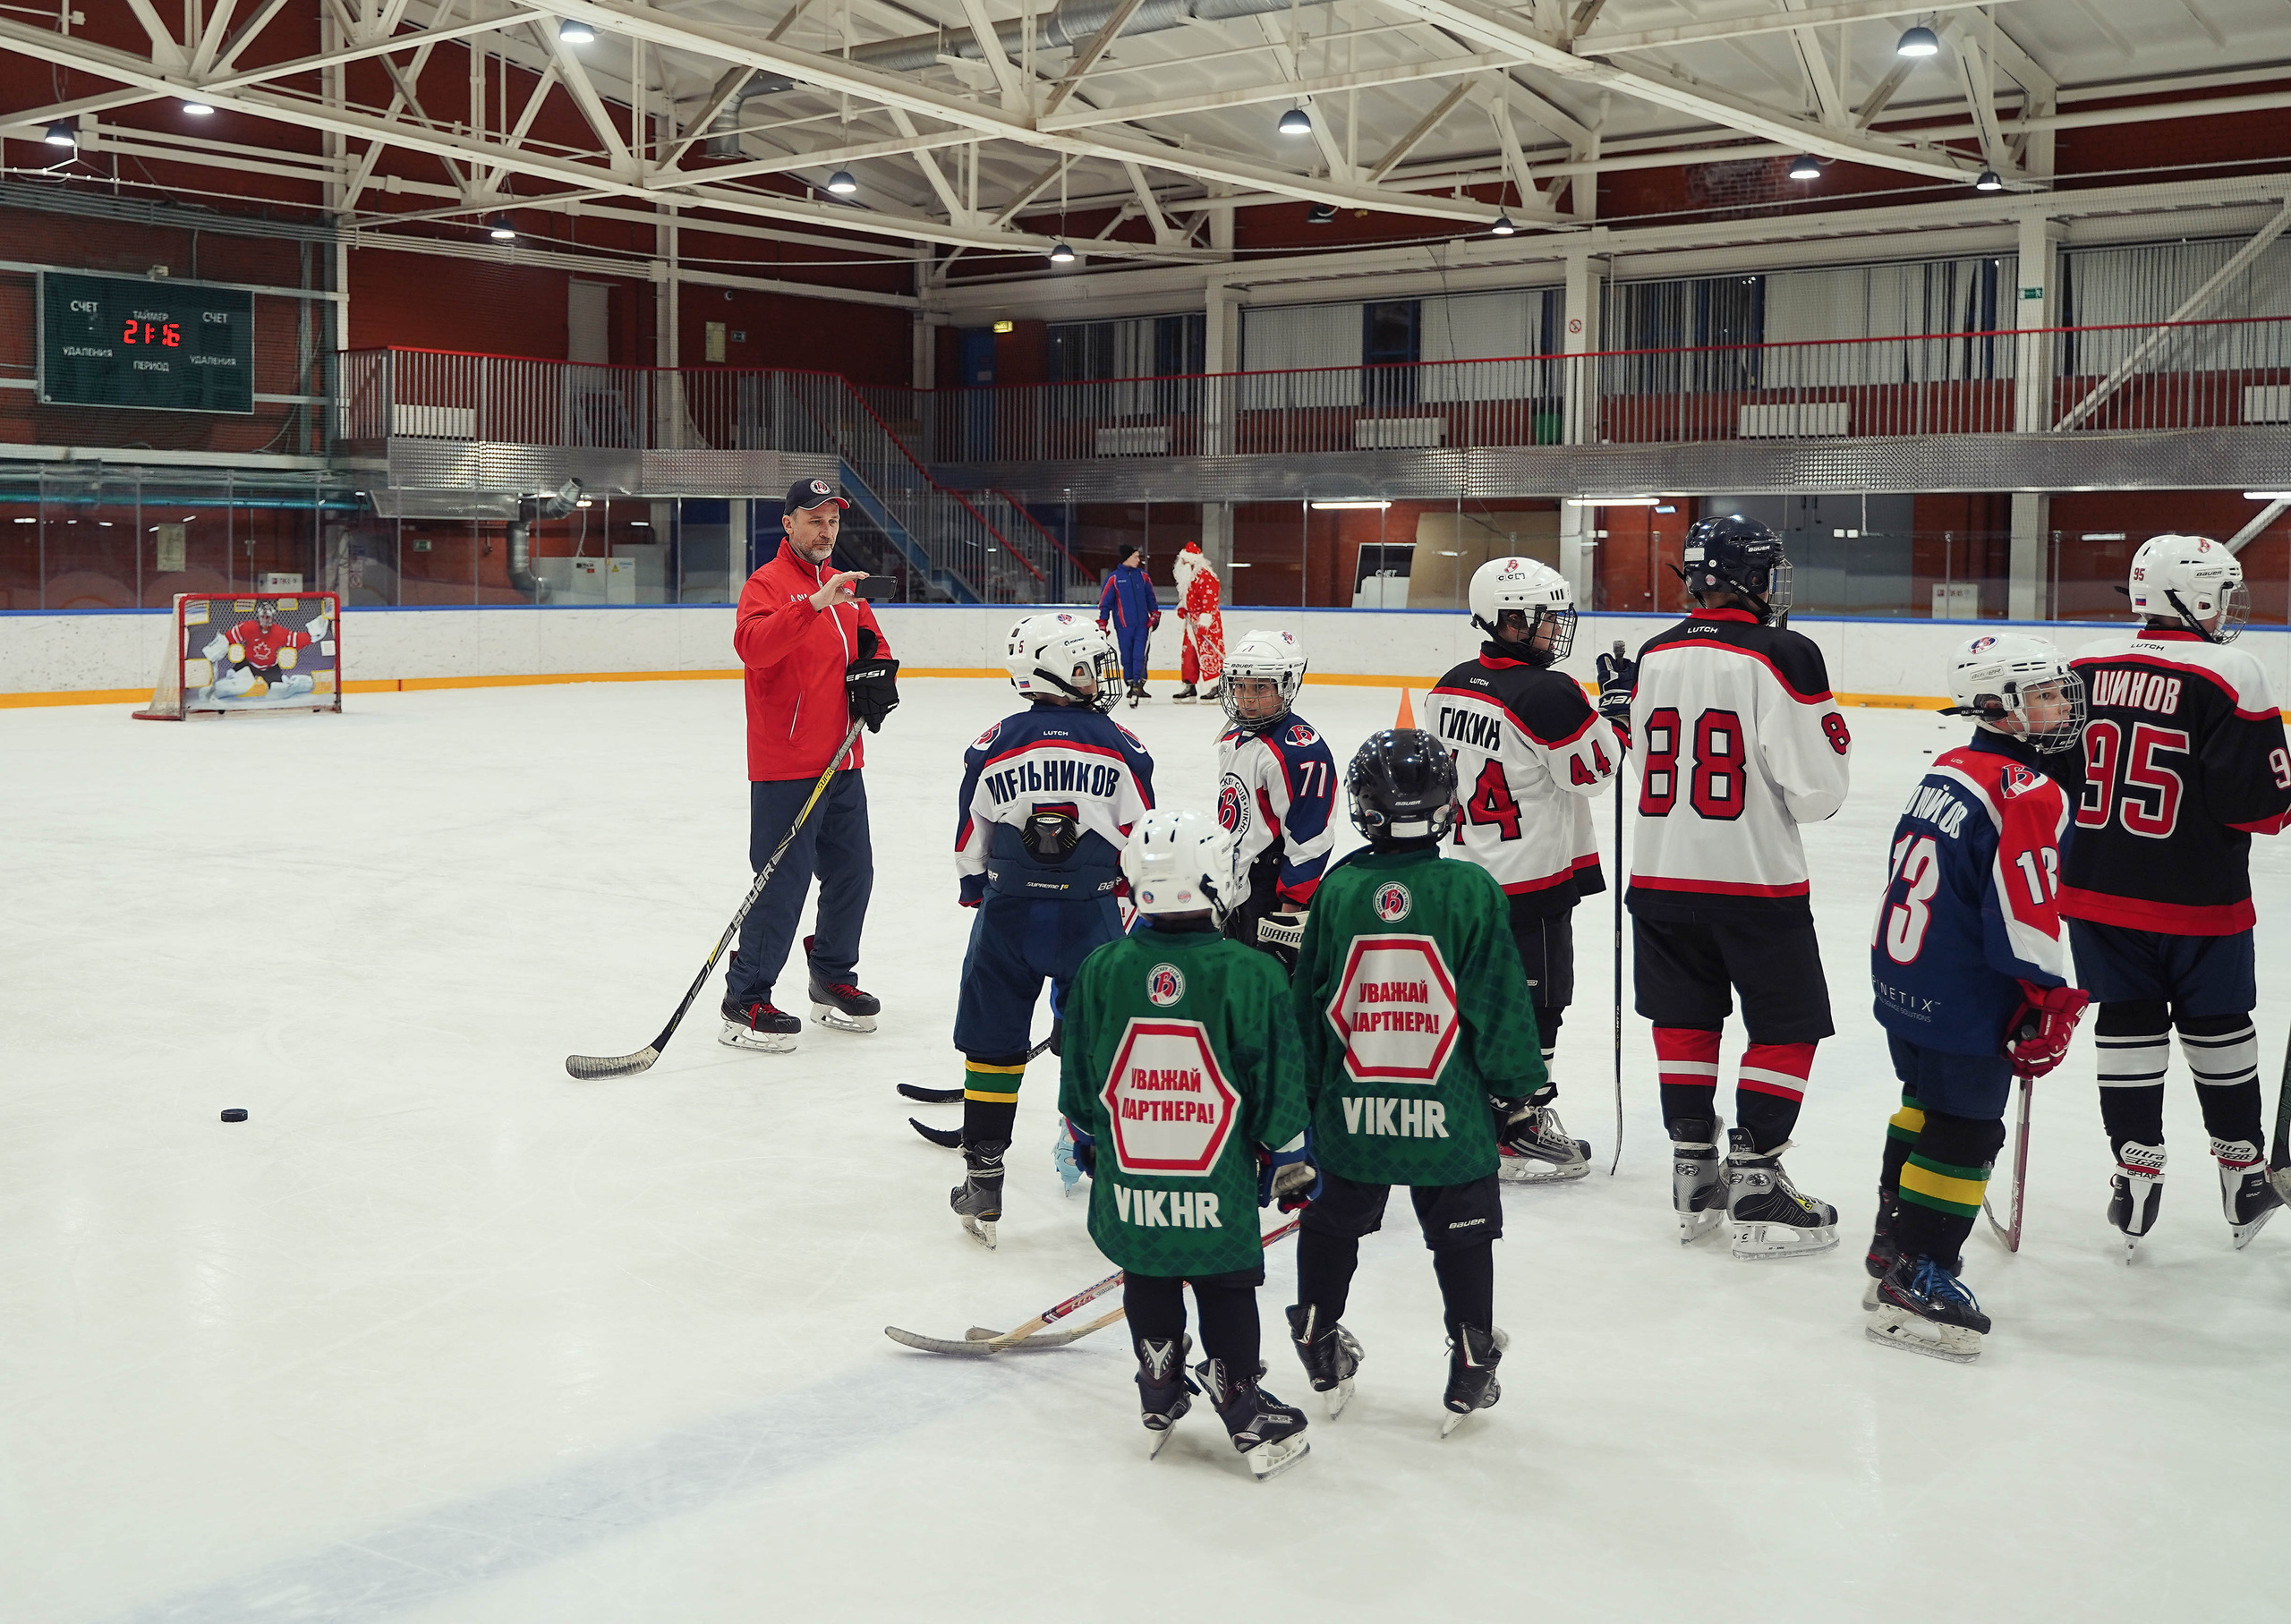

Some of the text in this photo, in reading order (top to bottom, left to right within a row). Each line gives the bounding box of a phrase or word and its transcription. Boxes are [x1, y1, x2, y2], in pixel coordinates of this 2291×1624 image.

[70, 300, 98, 312] СЧЕТ
[133, 310, 169, 321] ТАЙМЕР
[202, 311, 228, 323] СЧЕТ
[63, 346, 113, 357] УДАЛЕНИЯ
[133, 361, 170, 372] ПЕРИОД
[189, 355, 236, 367] УДАЛЕНИЯ
[1496, 573, 1525, 582] CCM
[2133, 567, 2145, 581] 95
[1687, 626, 1718, 634] LUTCH
[846, 669, 886, 682] EFSI
[1469, 676, 1489, 687] LUTCH
[1821, 711, 1851, 755] 8
[1570, 739, 1611, 786] 44
[1638, 707, 1747, 821] 88
[1299, 761, 1327, 798] 71
[2074, 718, 2189, 839] 95
[1026, 881, 1060, 889] SUPREME
[731, 862, 775, 930] BAUER
[1871, 831, 1939, 965] 13
[1358, 979, 1428, 1004] УВАЖАЙ
[1130, 1067, 1201, 1093] УВАЖАЙ
[1121, 1098, 1214, 1125] ПАРТНЕРА!
[1341, 1097, 1450, 1138] VIKHR
[2126, 1169, 2158, 1180] GRAF
[1113, 1183, 1223, 1228] VIKHR
[1449, 1218, 1486, 1229] BAUER
